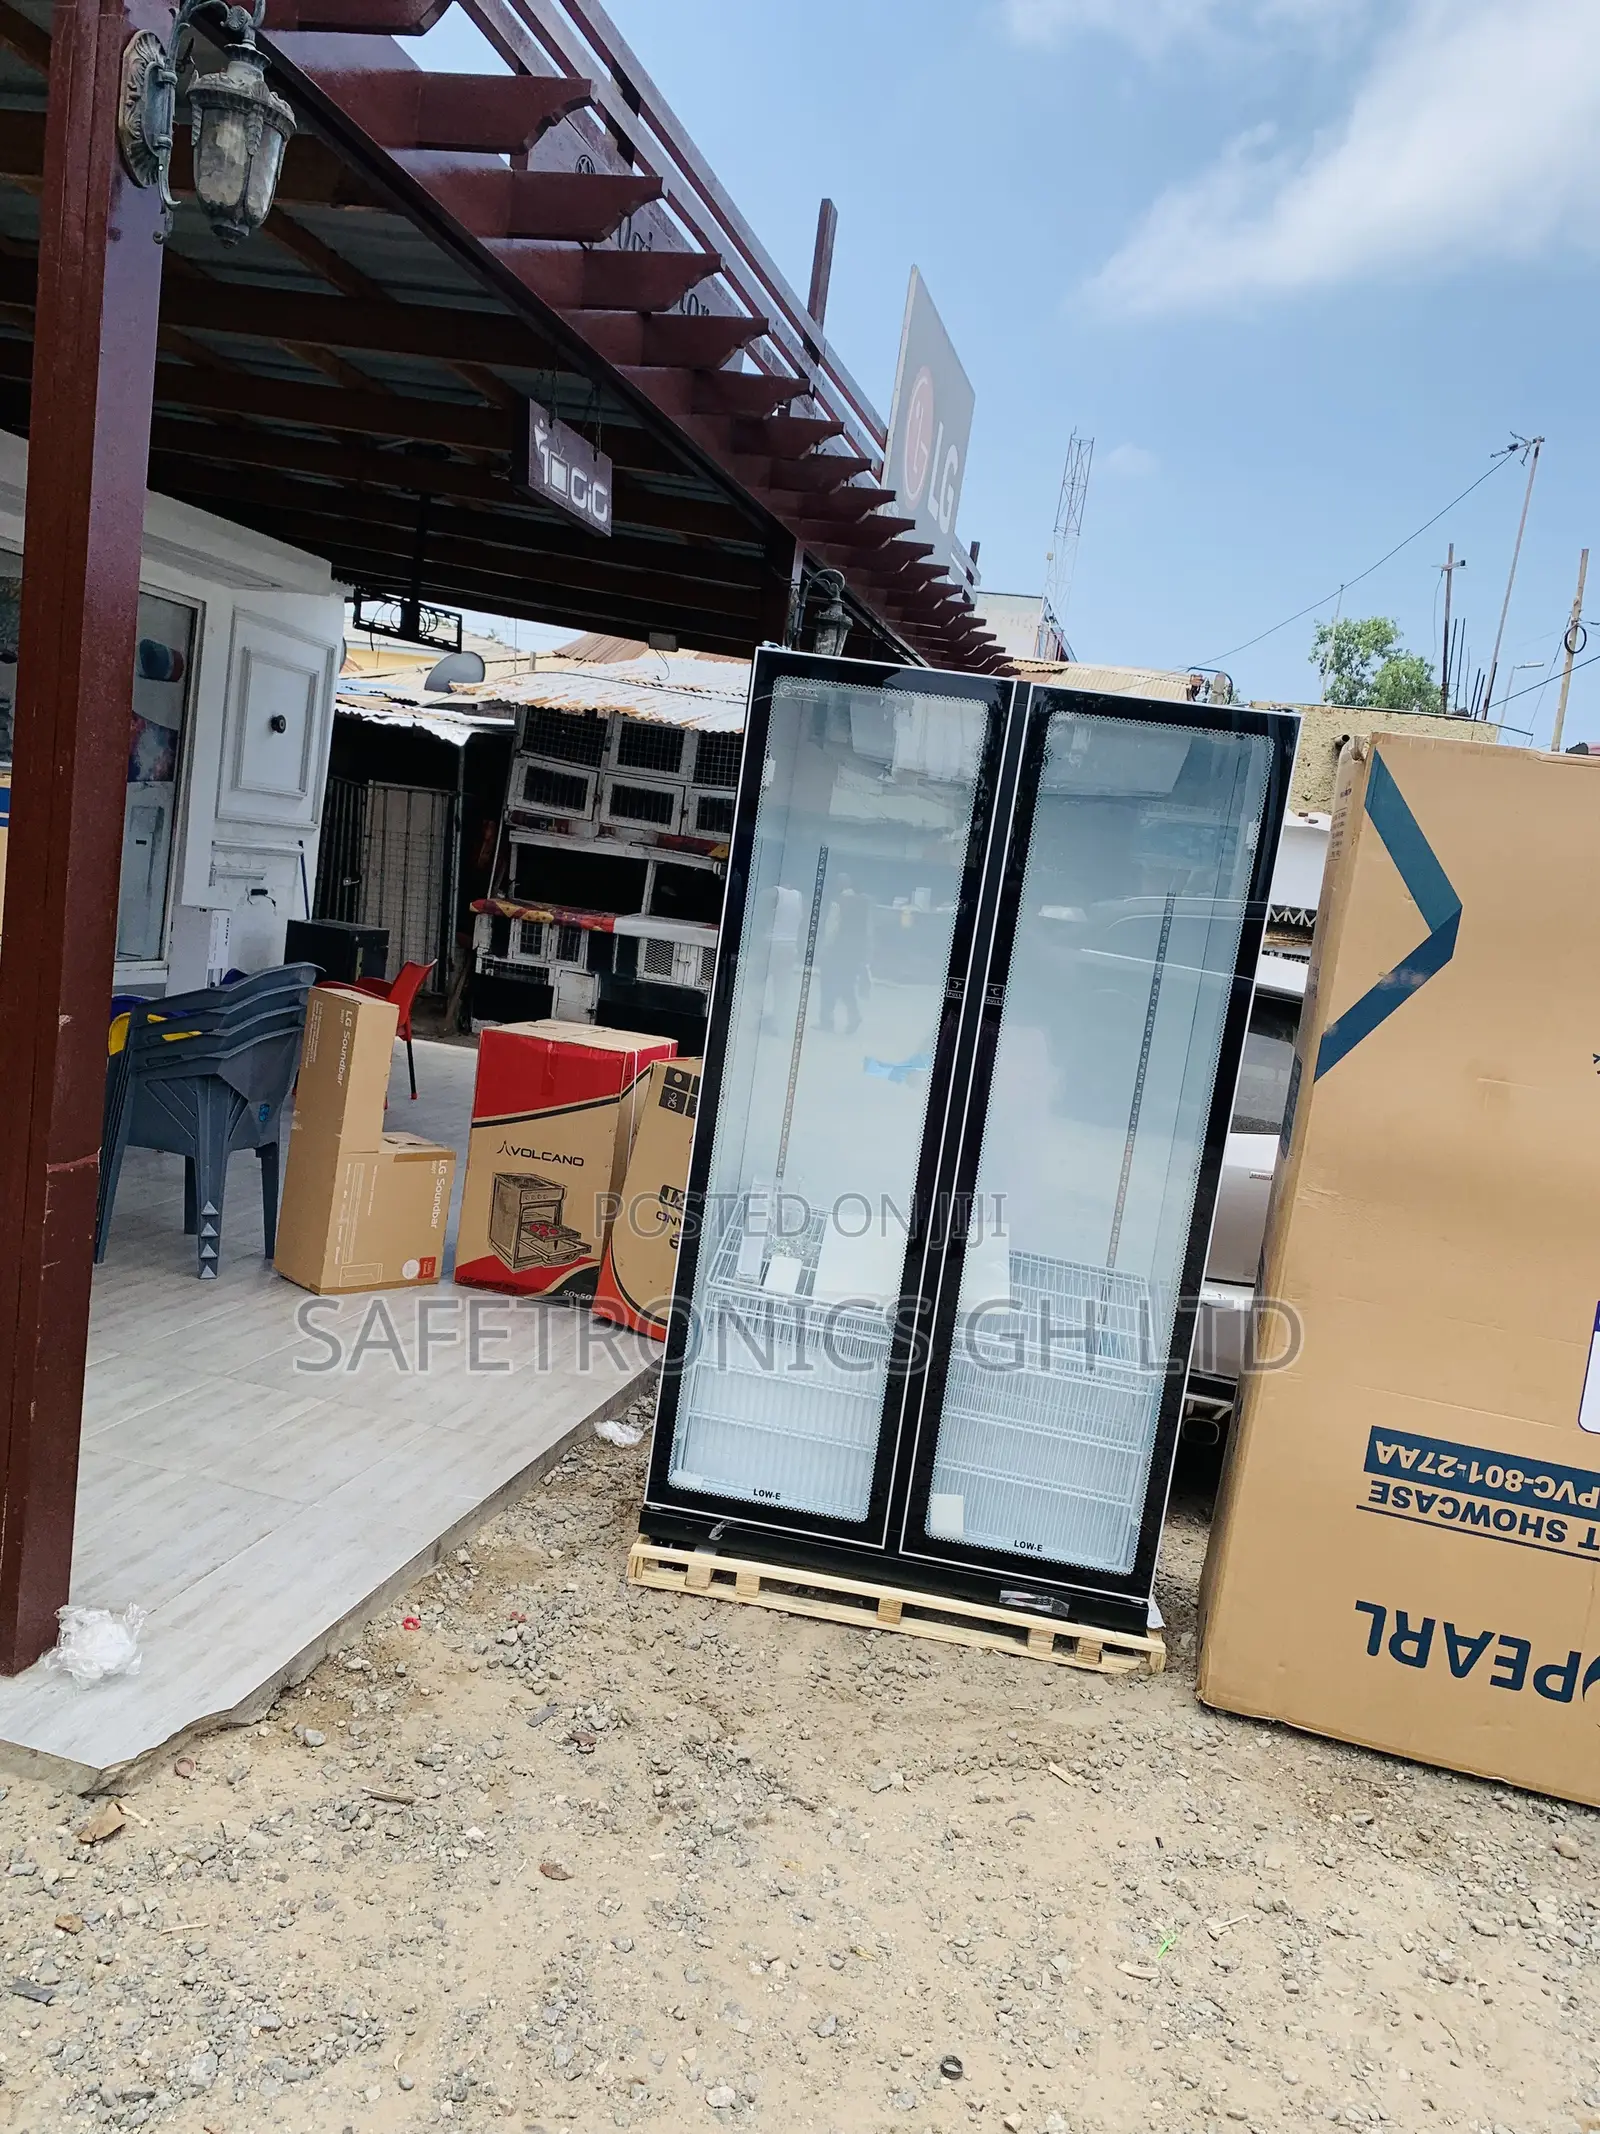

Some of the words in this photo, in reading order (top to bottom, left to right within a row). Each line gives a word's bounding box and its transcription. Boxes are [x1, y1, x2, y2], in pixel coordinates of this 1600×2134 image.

[927, 420, 959, 534] LG
[344, 1010, 353, 1028] LG
[337, 1030, 351, 1087] Soundbar
[438, 1159, 448, 1175] LG
[510, 1146, 584, 1167] VOLCANO
[431, 1178, 445, 1229] Soundbar
[753, 1488, 781, 1500] LOW-E
[1375, 1440, 1600, 1510] PVC-801-27AA
[1368, 1480, 1569, 1543] SHOWCASE
[1014, 1540, 1043, 1552] LOW-E
[1355, 1600, 1582, 1703] PEARL
